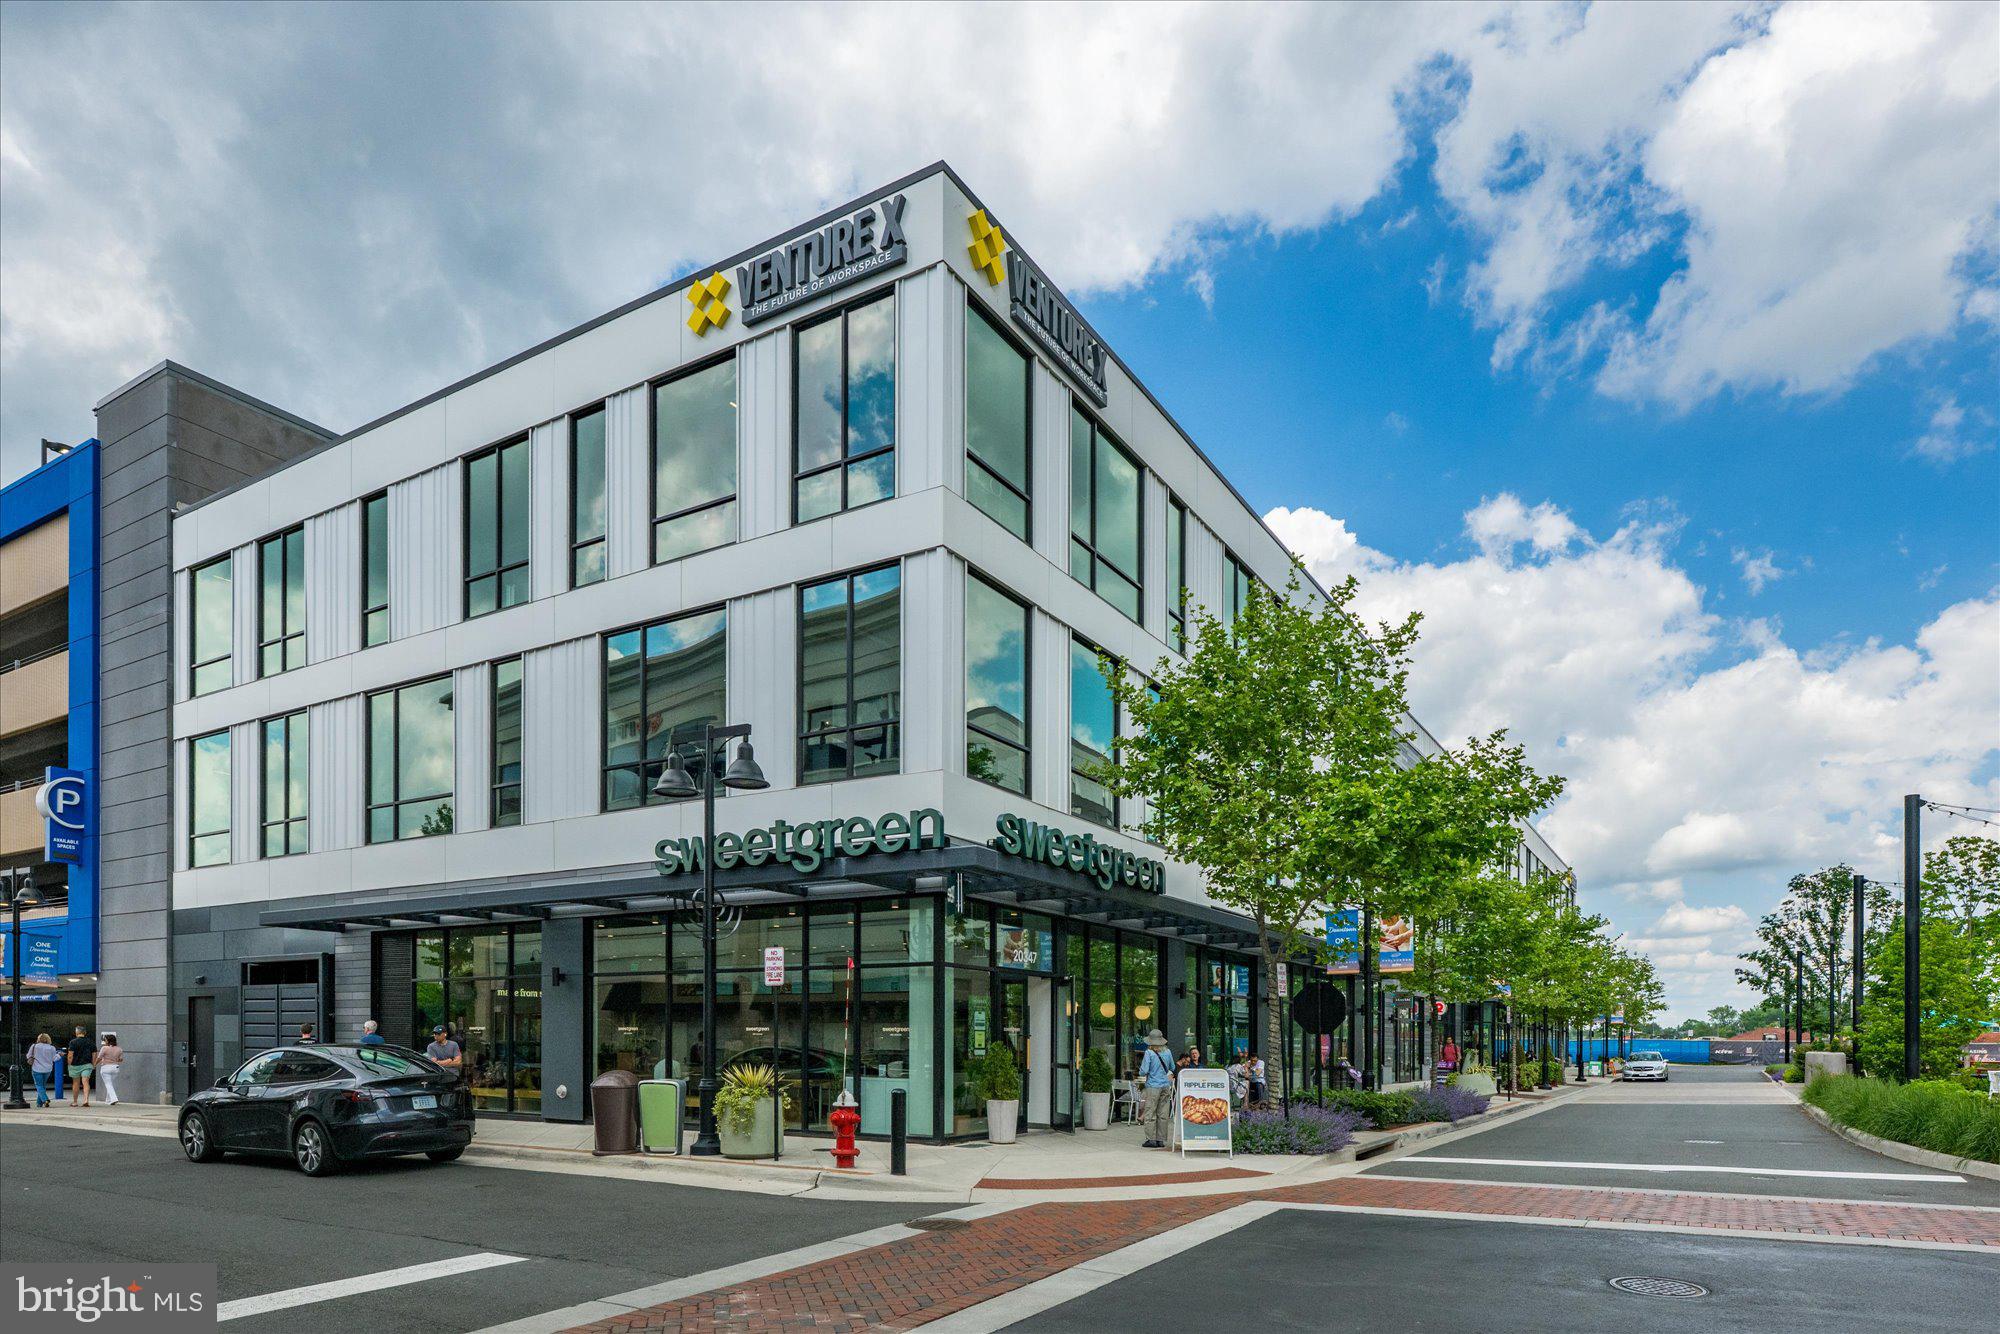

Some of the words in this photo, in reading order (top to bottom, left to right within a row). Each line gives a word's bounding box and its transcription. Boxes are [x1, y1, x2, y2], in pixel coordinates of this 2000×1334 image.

[736, 207, 876, 309] VENTURE
[880, 193, 906, 250] X
[750, 302, 768, 317] THE
[771, 285, 808, 311] FUTURE
[811, 278, 825, 291] OF
[828, 251, 892, 284] WORKSPACE
[1006, 250, 1094, 376] VENTURE
[1091, 344, 1108, 392] X
[1023, 311, 1036, 331] THE
[1037, 325, 1061, 354] FUTURE
[1061, 350, 1070, 363] OF
[1071, 361, 1105, 398] WORKSPACE
[56, 788, 81, 813] P
[53, 837, 79, 845] AVAILABLE
[655, 808, 945, 875] sweetgreen
[996, 813, 1167, 895] sweetgreen
[1013, 949, 1037, 964] 20347
[520, 988, 538, 997] from
